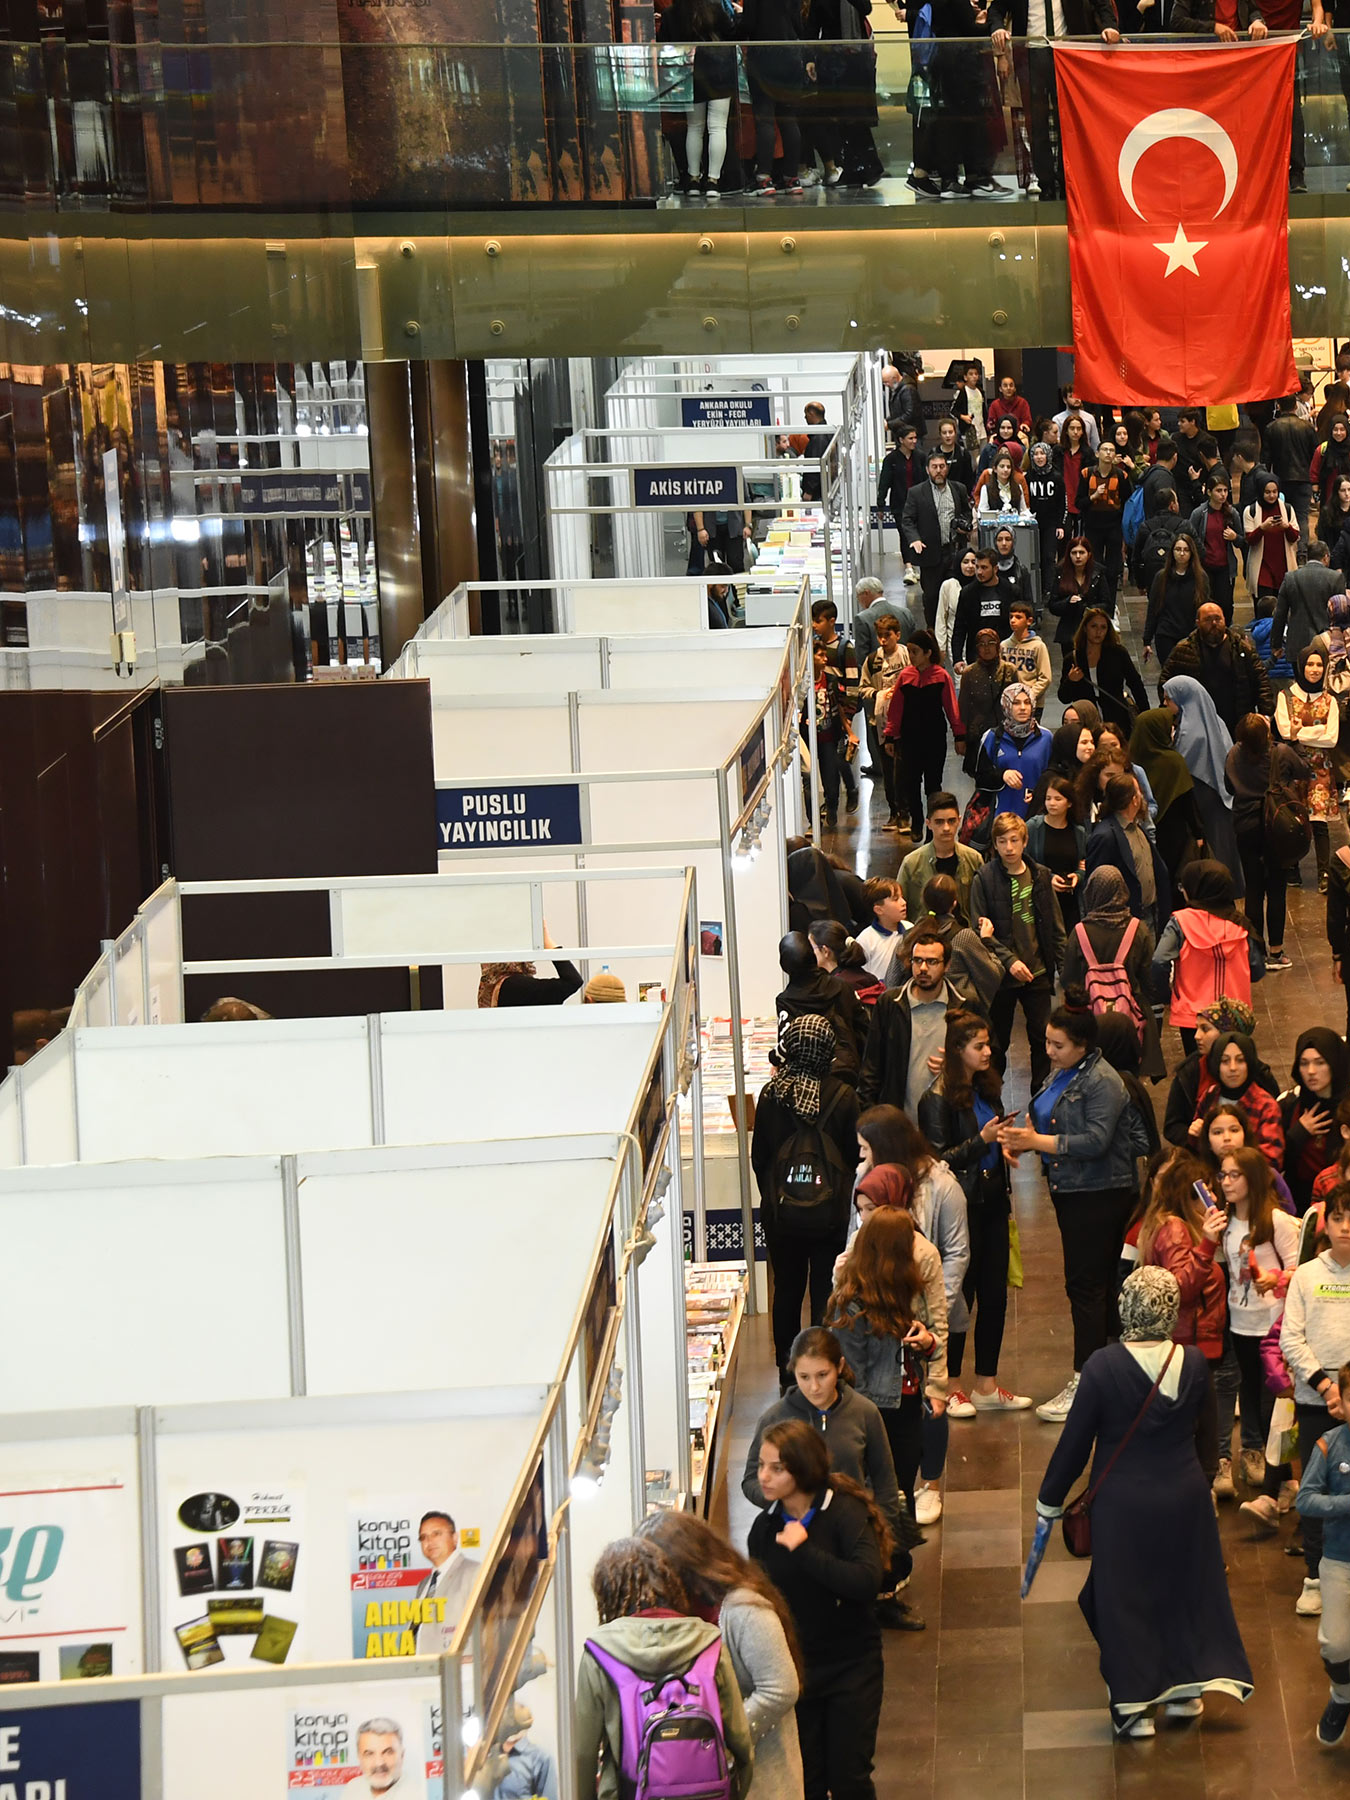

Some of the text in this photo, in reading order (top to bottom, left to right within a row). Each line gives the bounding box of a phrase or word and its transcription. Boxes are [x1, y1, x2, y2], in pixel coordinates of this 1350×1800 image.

[700, 401, 753, 410] ANKARA OKULU
[706, 410, 723, 419] EKİN
[724, 418, 762, 428] YAYINLARI
[650, 477, 723, 495] AKİS KİTAP
[1030, 481, 1055, 497] NYC
[462, 793, 526, 816] PUSLU
[440, 818, 551, 843] YAYINCILIK
[358, 1519, 410, 1533] konya
[359, 1534, 411, 1551] kitap
[359, 1550, 411, 1570] günleri
[365, 1597, 448, 1627] AHMET
[366, 1630, 416, 1659] AKA
[294, 1713, 348, 1728] konya
[295, 1729, 348, 1748] kitap
